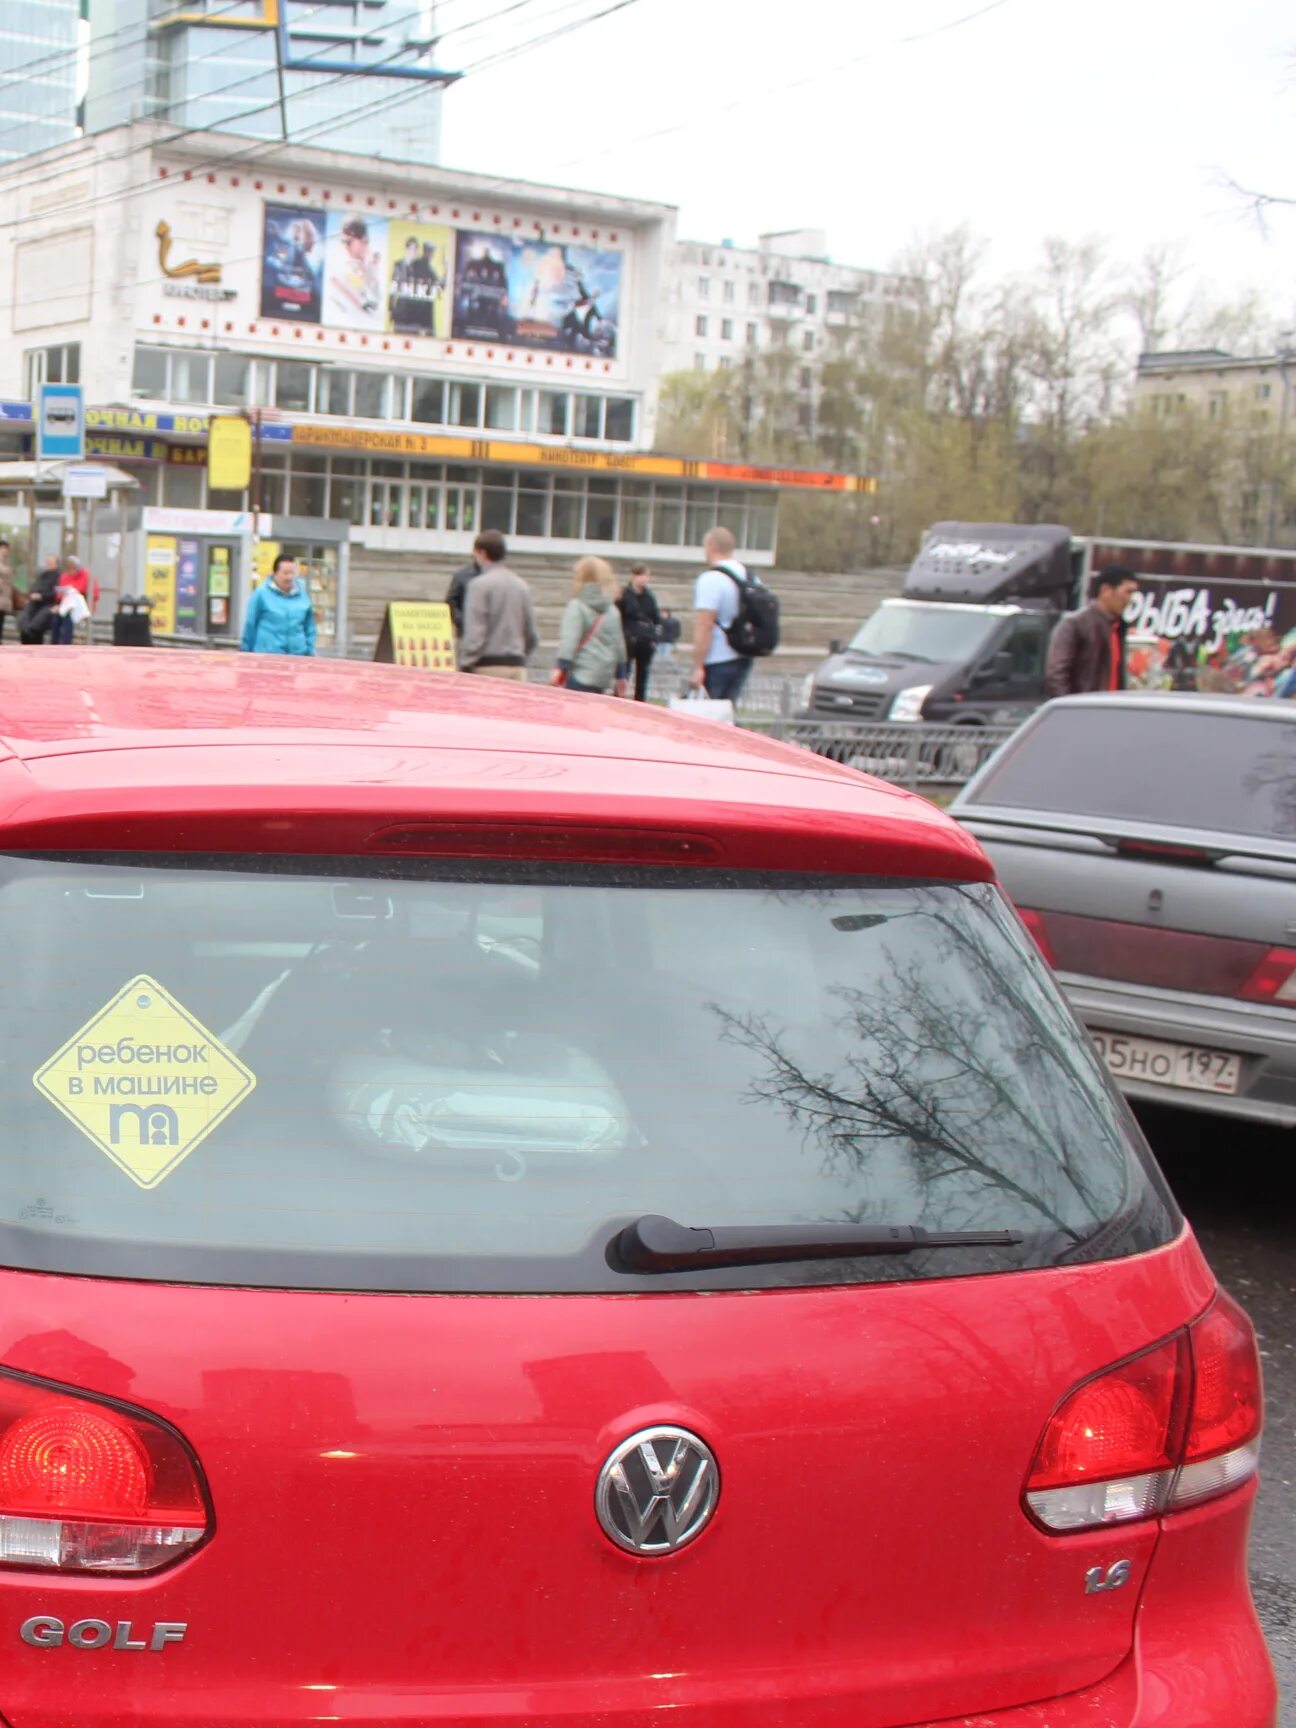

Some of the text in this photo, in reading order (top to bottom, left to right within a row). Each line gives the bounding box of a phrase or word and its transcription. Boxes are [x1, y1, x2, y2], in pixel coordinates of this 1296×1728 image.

[84, 410, 158, 430] ОЧНАЯ
[77, 1037, 209, 1070] ребенок
[1181, 1051, 1231, 1077] 197
[68, 1075, 218, 1095] в машине
[20, 1615, 188, 1651] GOLF
